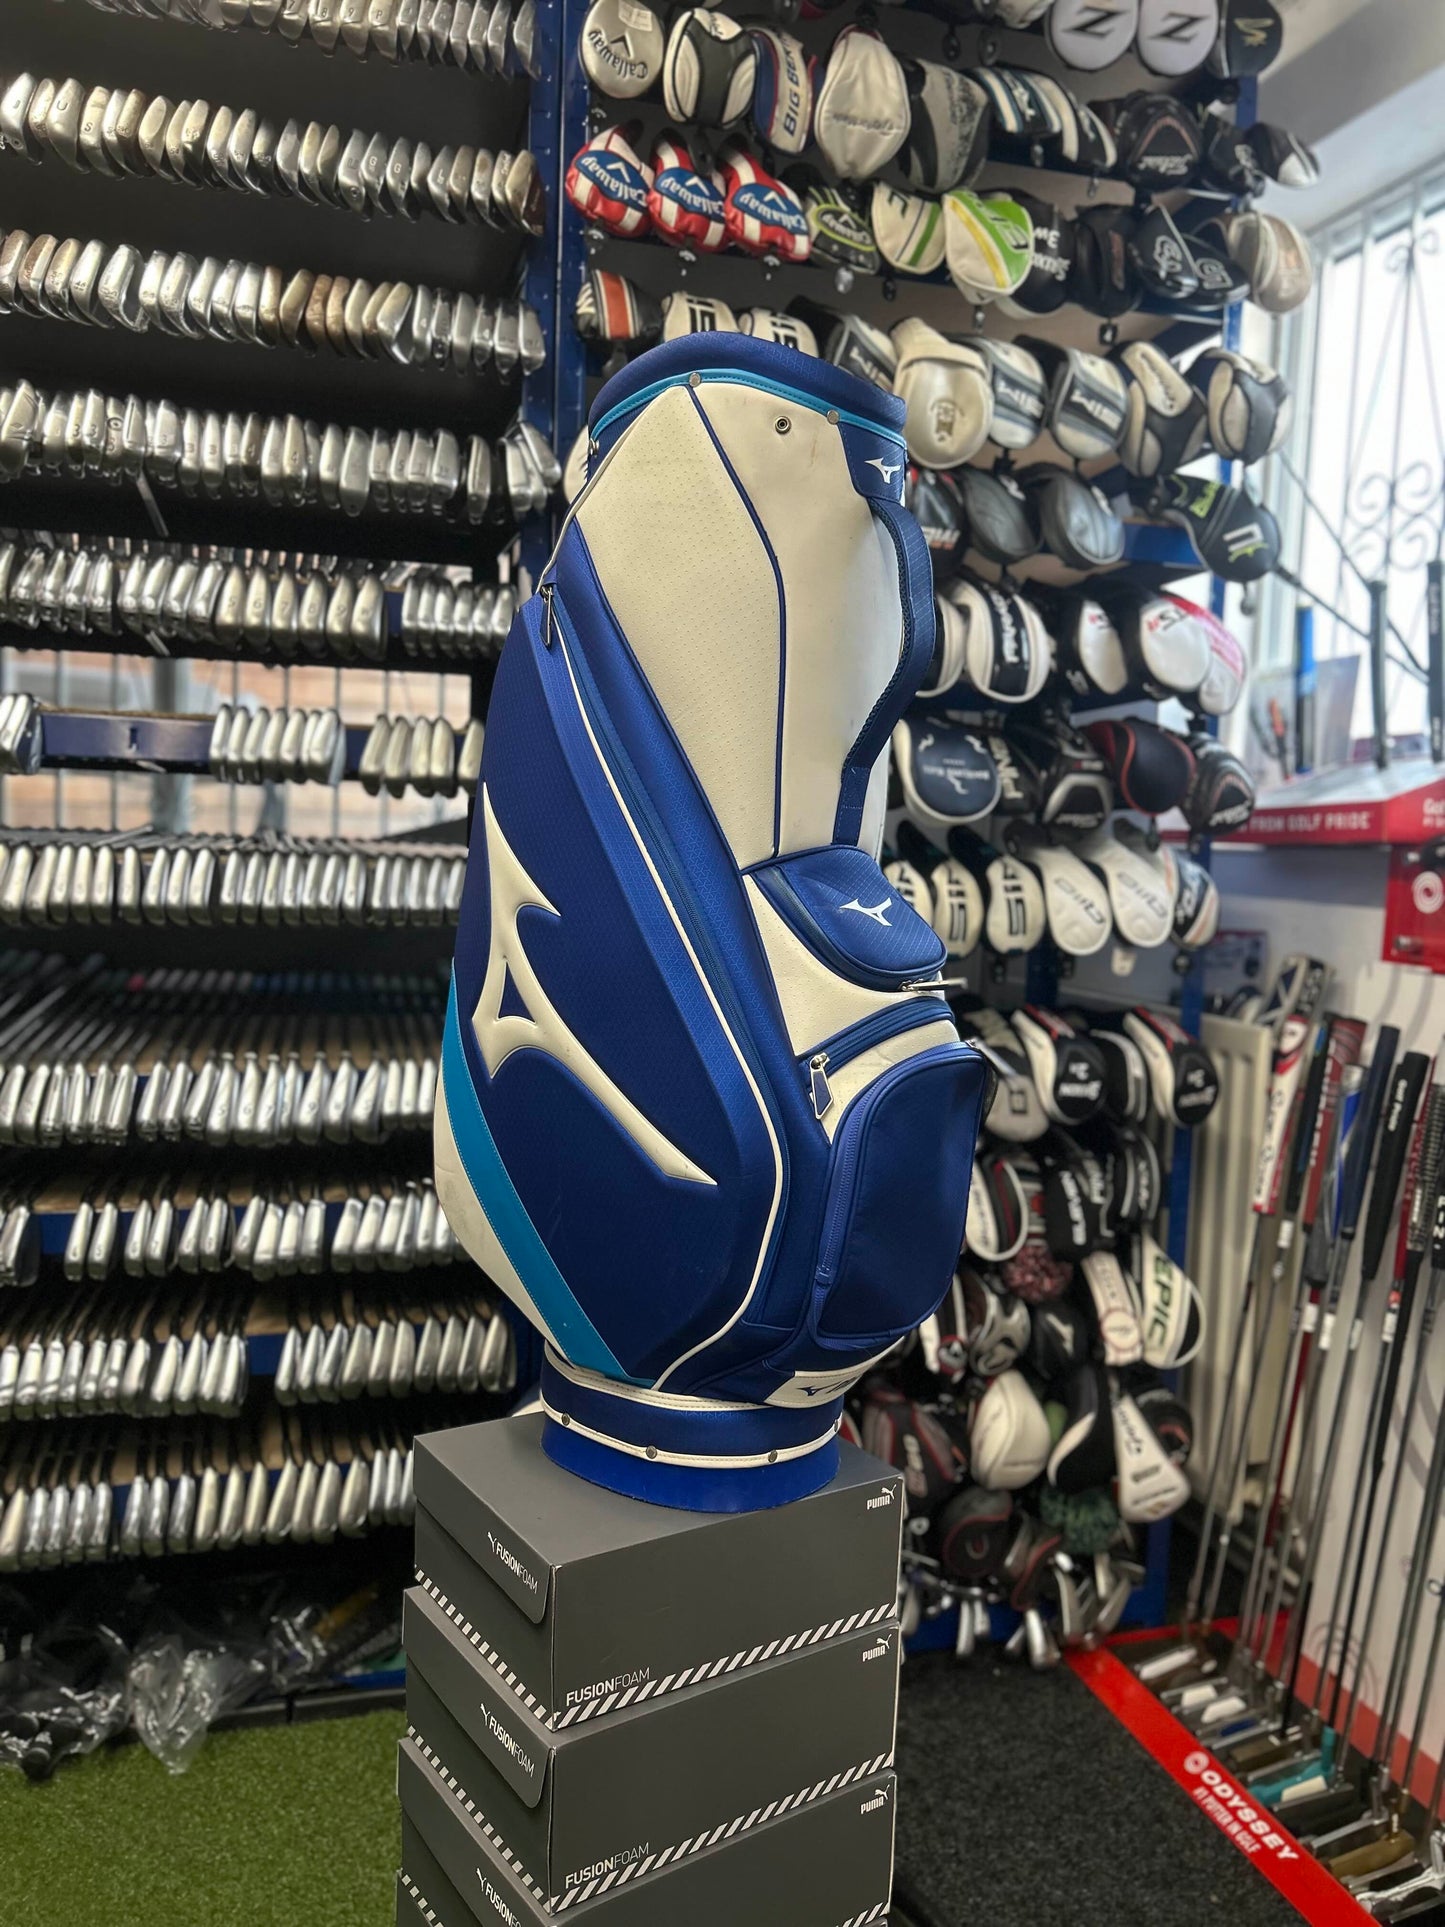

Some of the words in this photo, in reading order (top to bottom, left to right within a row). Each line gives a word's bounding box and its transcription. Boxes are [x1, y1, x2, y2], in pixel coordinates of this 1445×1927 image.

[587, 28, 649, 80] Callaway
[83, 122, 93, 133] S
[782, 89, 801, 138] BIG
[580, 156, 648, 208] Callaway
[740, 192, 808, 232] Callaway
[1325, 810, 1370, 830] PRIDE
[1142, 1252, 1176, 1350] EPIC
[866, 1495, 892, 1510] PUMA
[495, 1541, 539, 1595] FUSIONFOAM
[862, 1645, 886, 1662] PUMA
[566, 1667, 650, 1707] FUSIONFOAM
[488, 1714, 535, 1778] FUSIONFOAM
[860, 1795, 884, 1815] PUMA
[1201, 1770, 1299, 1860] ODYSSEY
[1234, 1829, 1263, 1853] GOLF
[565, 1842, 650, 1890] FUSIONFOAM
